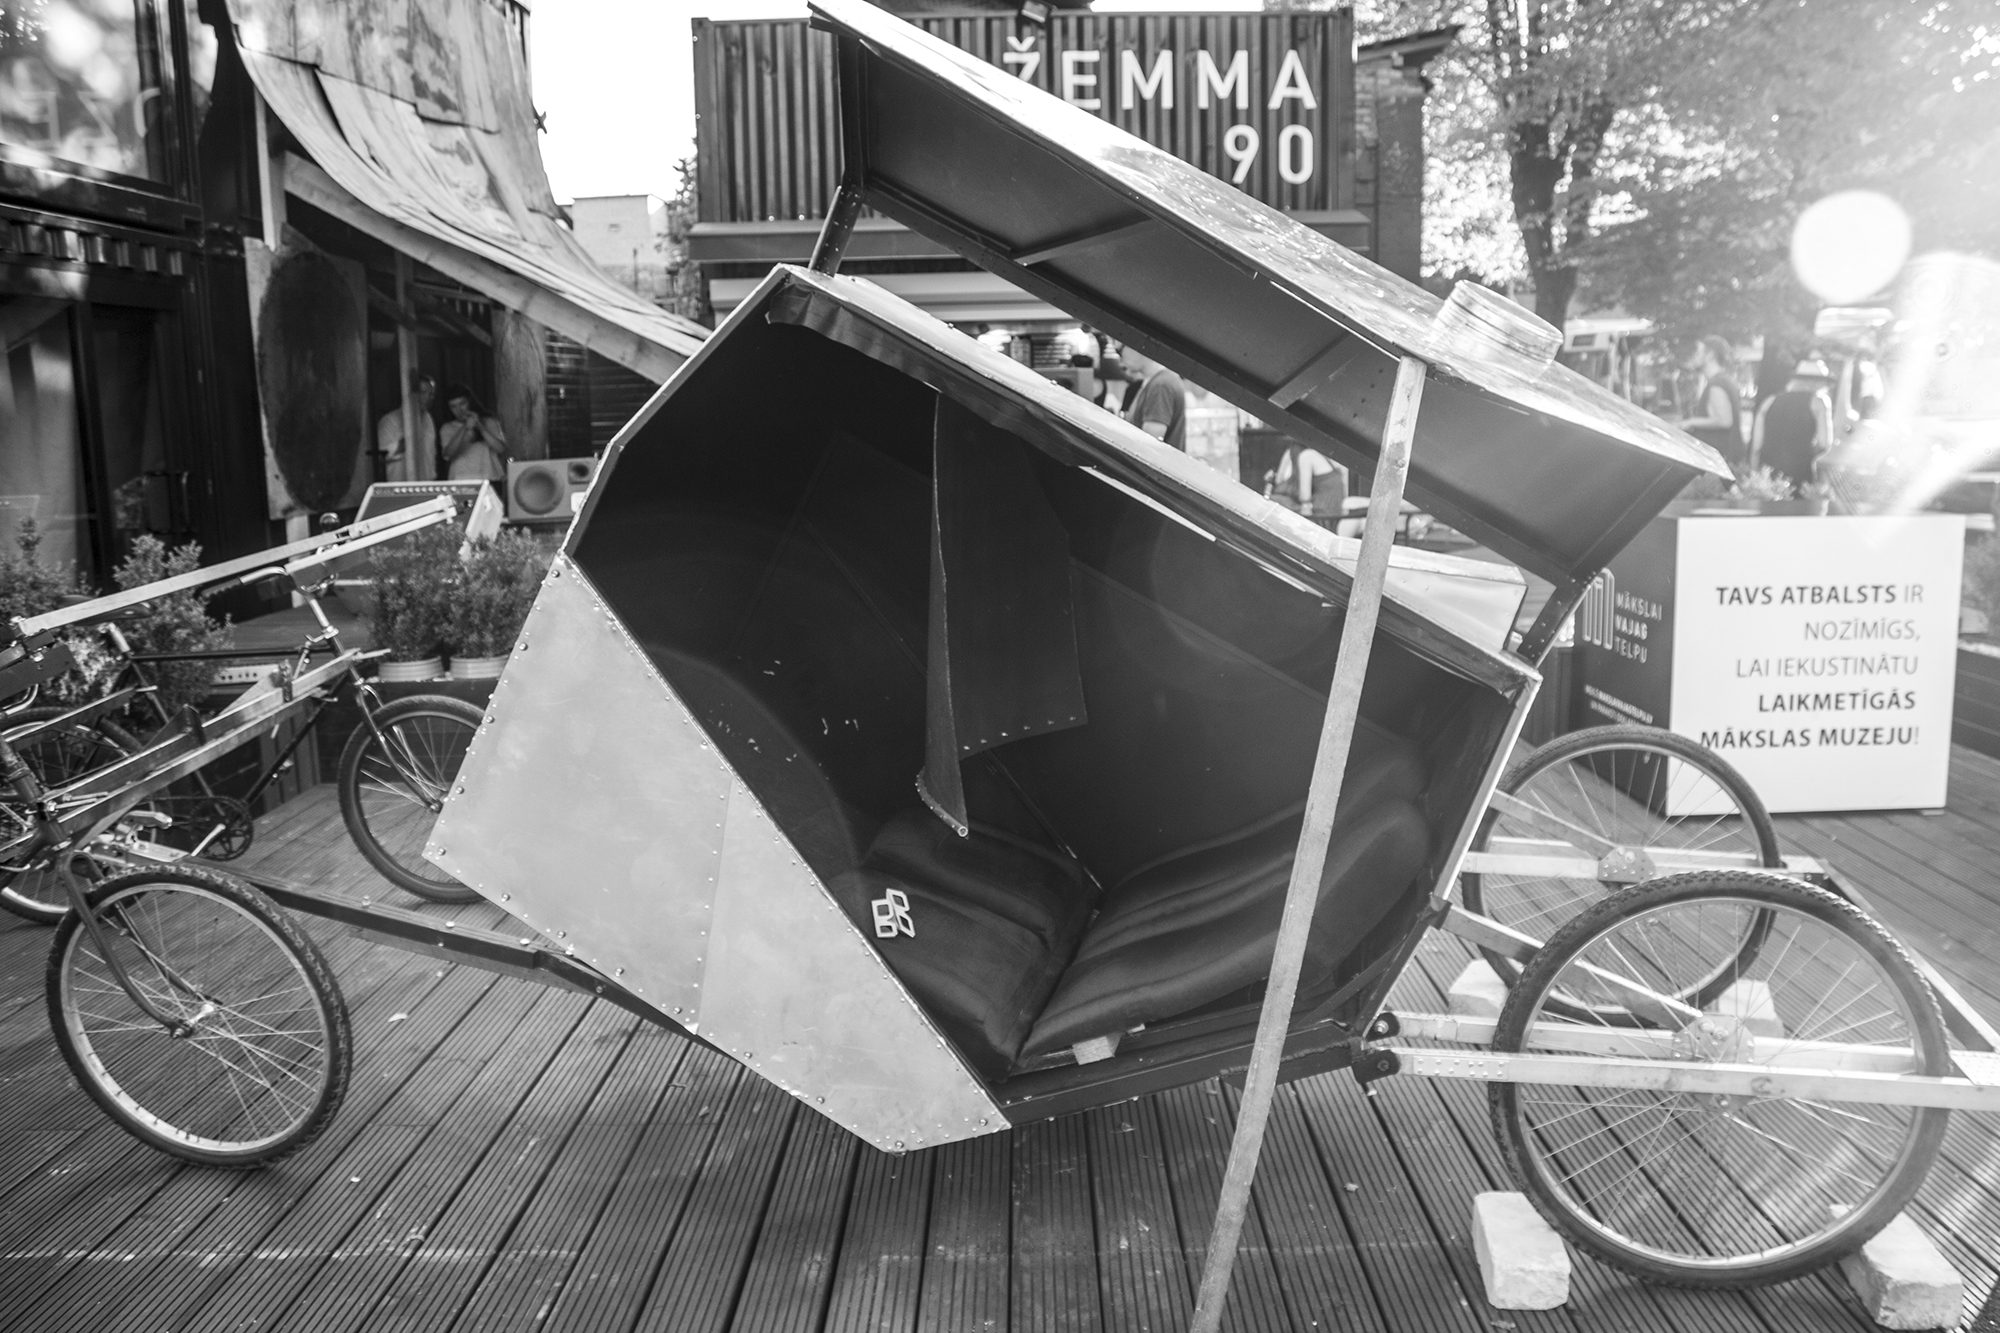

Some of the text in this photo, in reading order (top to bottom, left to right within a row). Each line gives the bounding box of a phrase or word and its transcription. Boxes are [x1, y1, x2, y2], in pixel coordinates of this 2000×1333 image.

[1223, 124, 1314, 184] 90
[1716, 584, 1924, 605] TAVS ATBALSTS IR
[1615, 614, 1648, 641] VAJAG
[1804, 618, 1921, 642] NOZĪMĪGS,
[1614, 636, 1648, 664] TELPU
[1736, 654, 1918, 678] LAI IEKUSTINĀTU
[1759, 688, 1916, 712] LAIKMETĪGĀS
[1701, 727, 1919, 749] MĀKSLAS MUZEJU!
